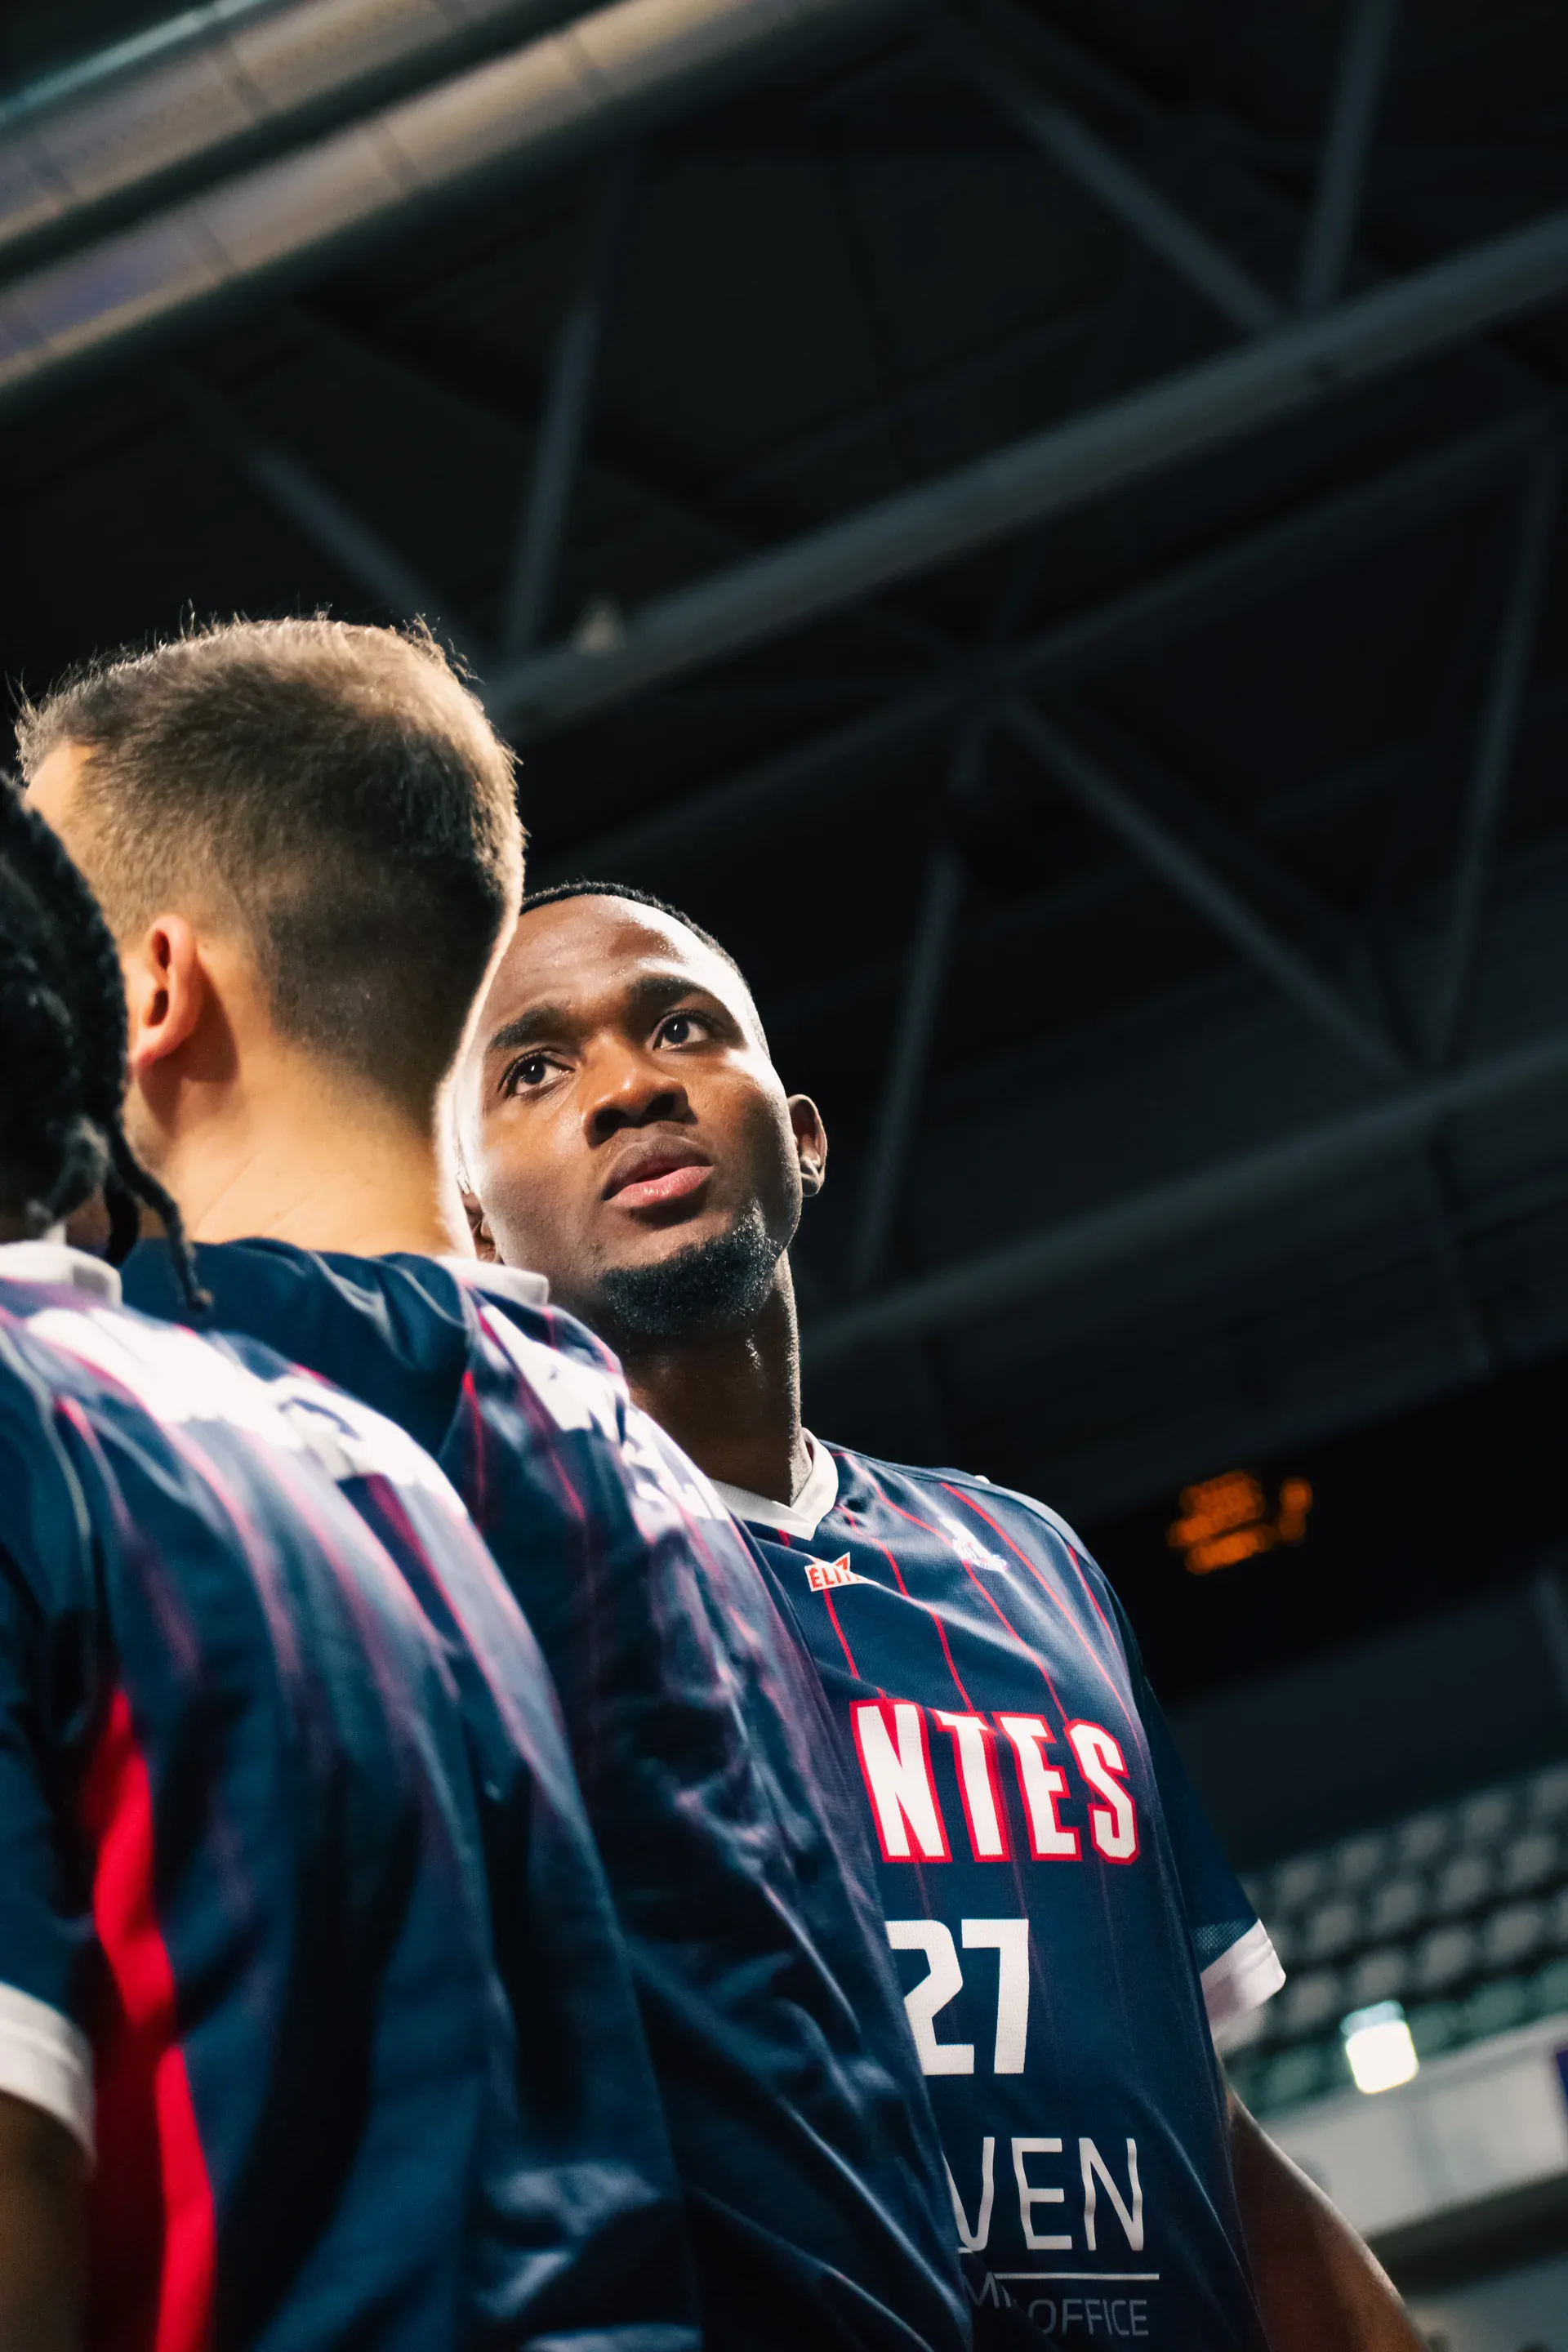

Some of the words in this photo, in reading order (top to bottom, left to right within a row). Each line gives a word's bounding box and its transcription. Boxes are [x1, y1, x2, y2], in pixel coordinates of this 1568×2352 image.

[849, 1698, 1140, 1865] NTES
[884, 1918, 1030, 2076] 27
[1027, 2298, 1150, 2336] OFFICE
